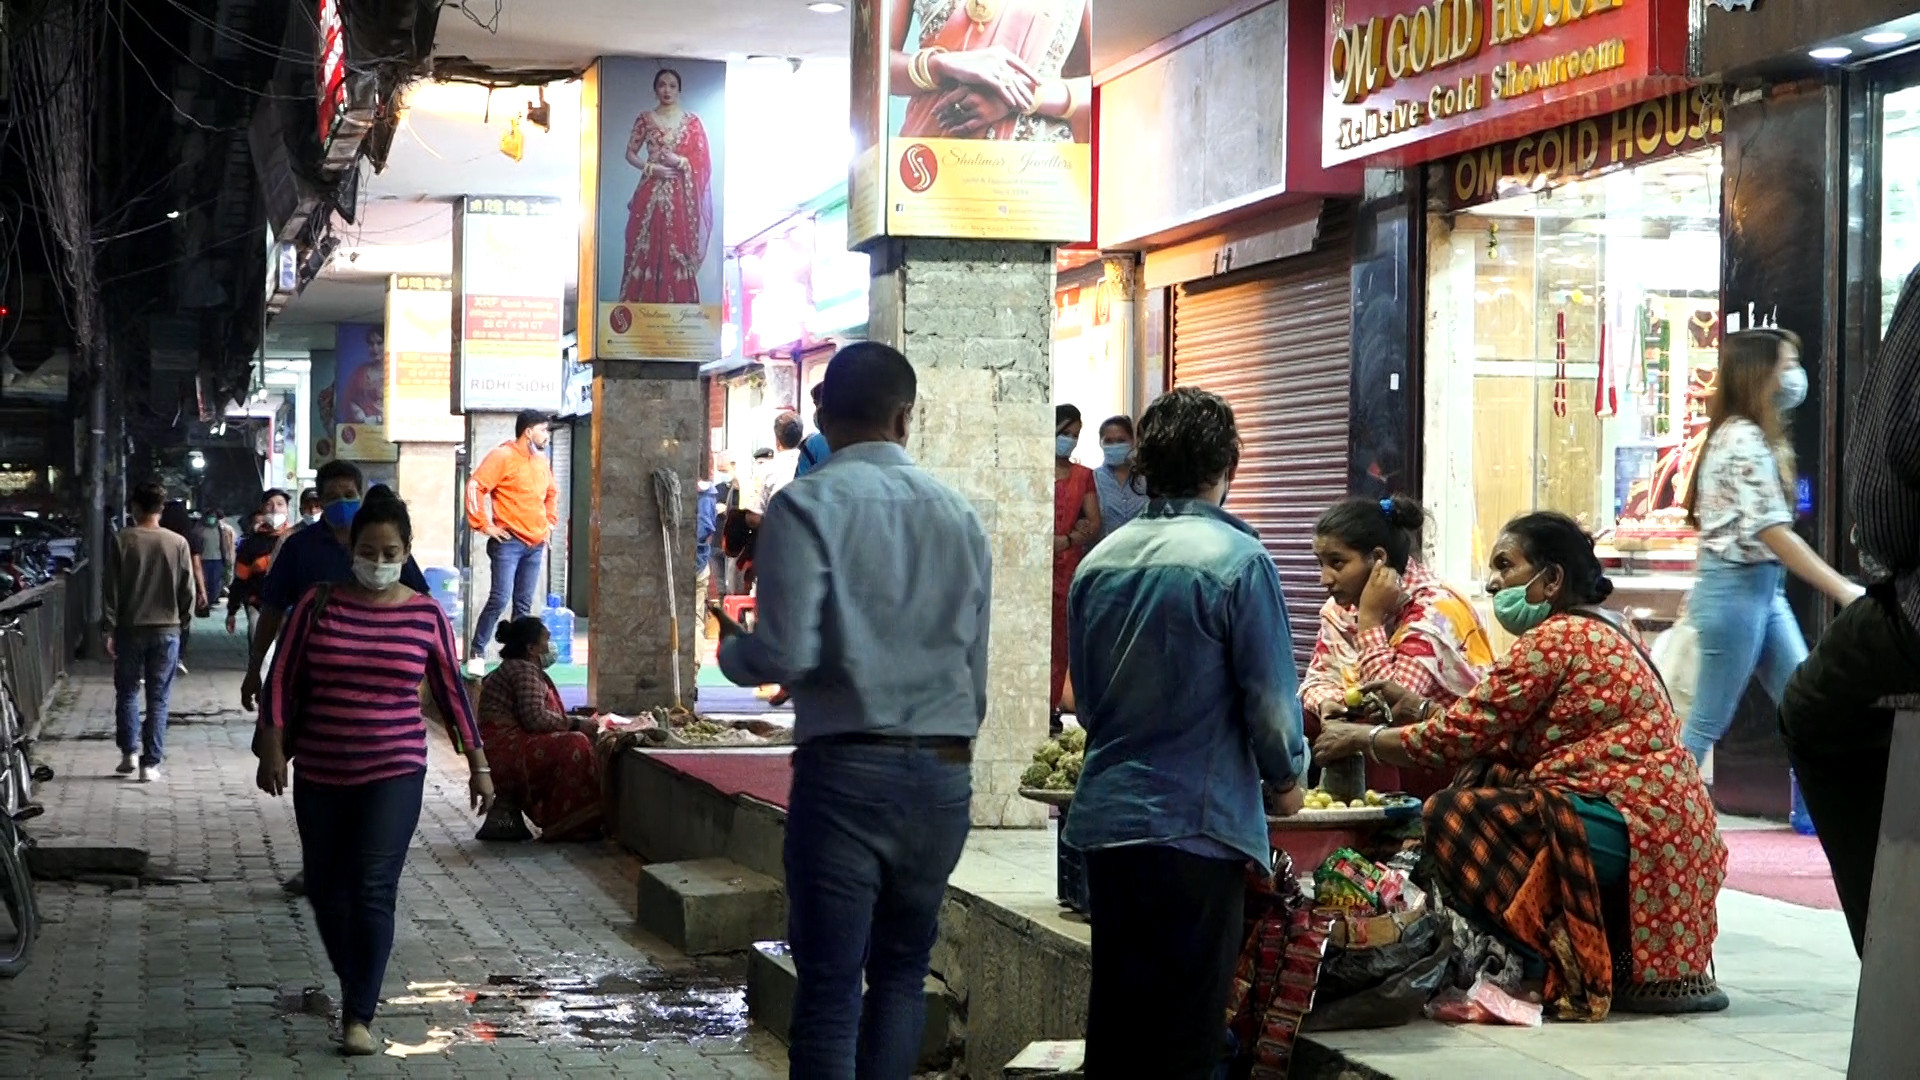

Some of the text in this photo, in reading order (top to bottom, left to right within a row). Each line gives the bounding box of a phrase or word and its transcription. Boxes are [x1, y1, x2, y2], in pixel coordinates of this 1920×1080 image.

[1330, 18, 1378, 103] OM
[1387, 0, 1476, 80] GOLD
[1429, 74, 1476, 120] Gold
[1491, 38, 1623, 100] Showroom
[1455, 147, 1500, 200] OM
[1513, 119, 1599, 183] GOLD
[470, 378, 556, 392] RIDHI SIDHI
